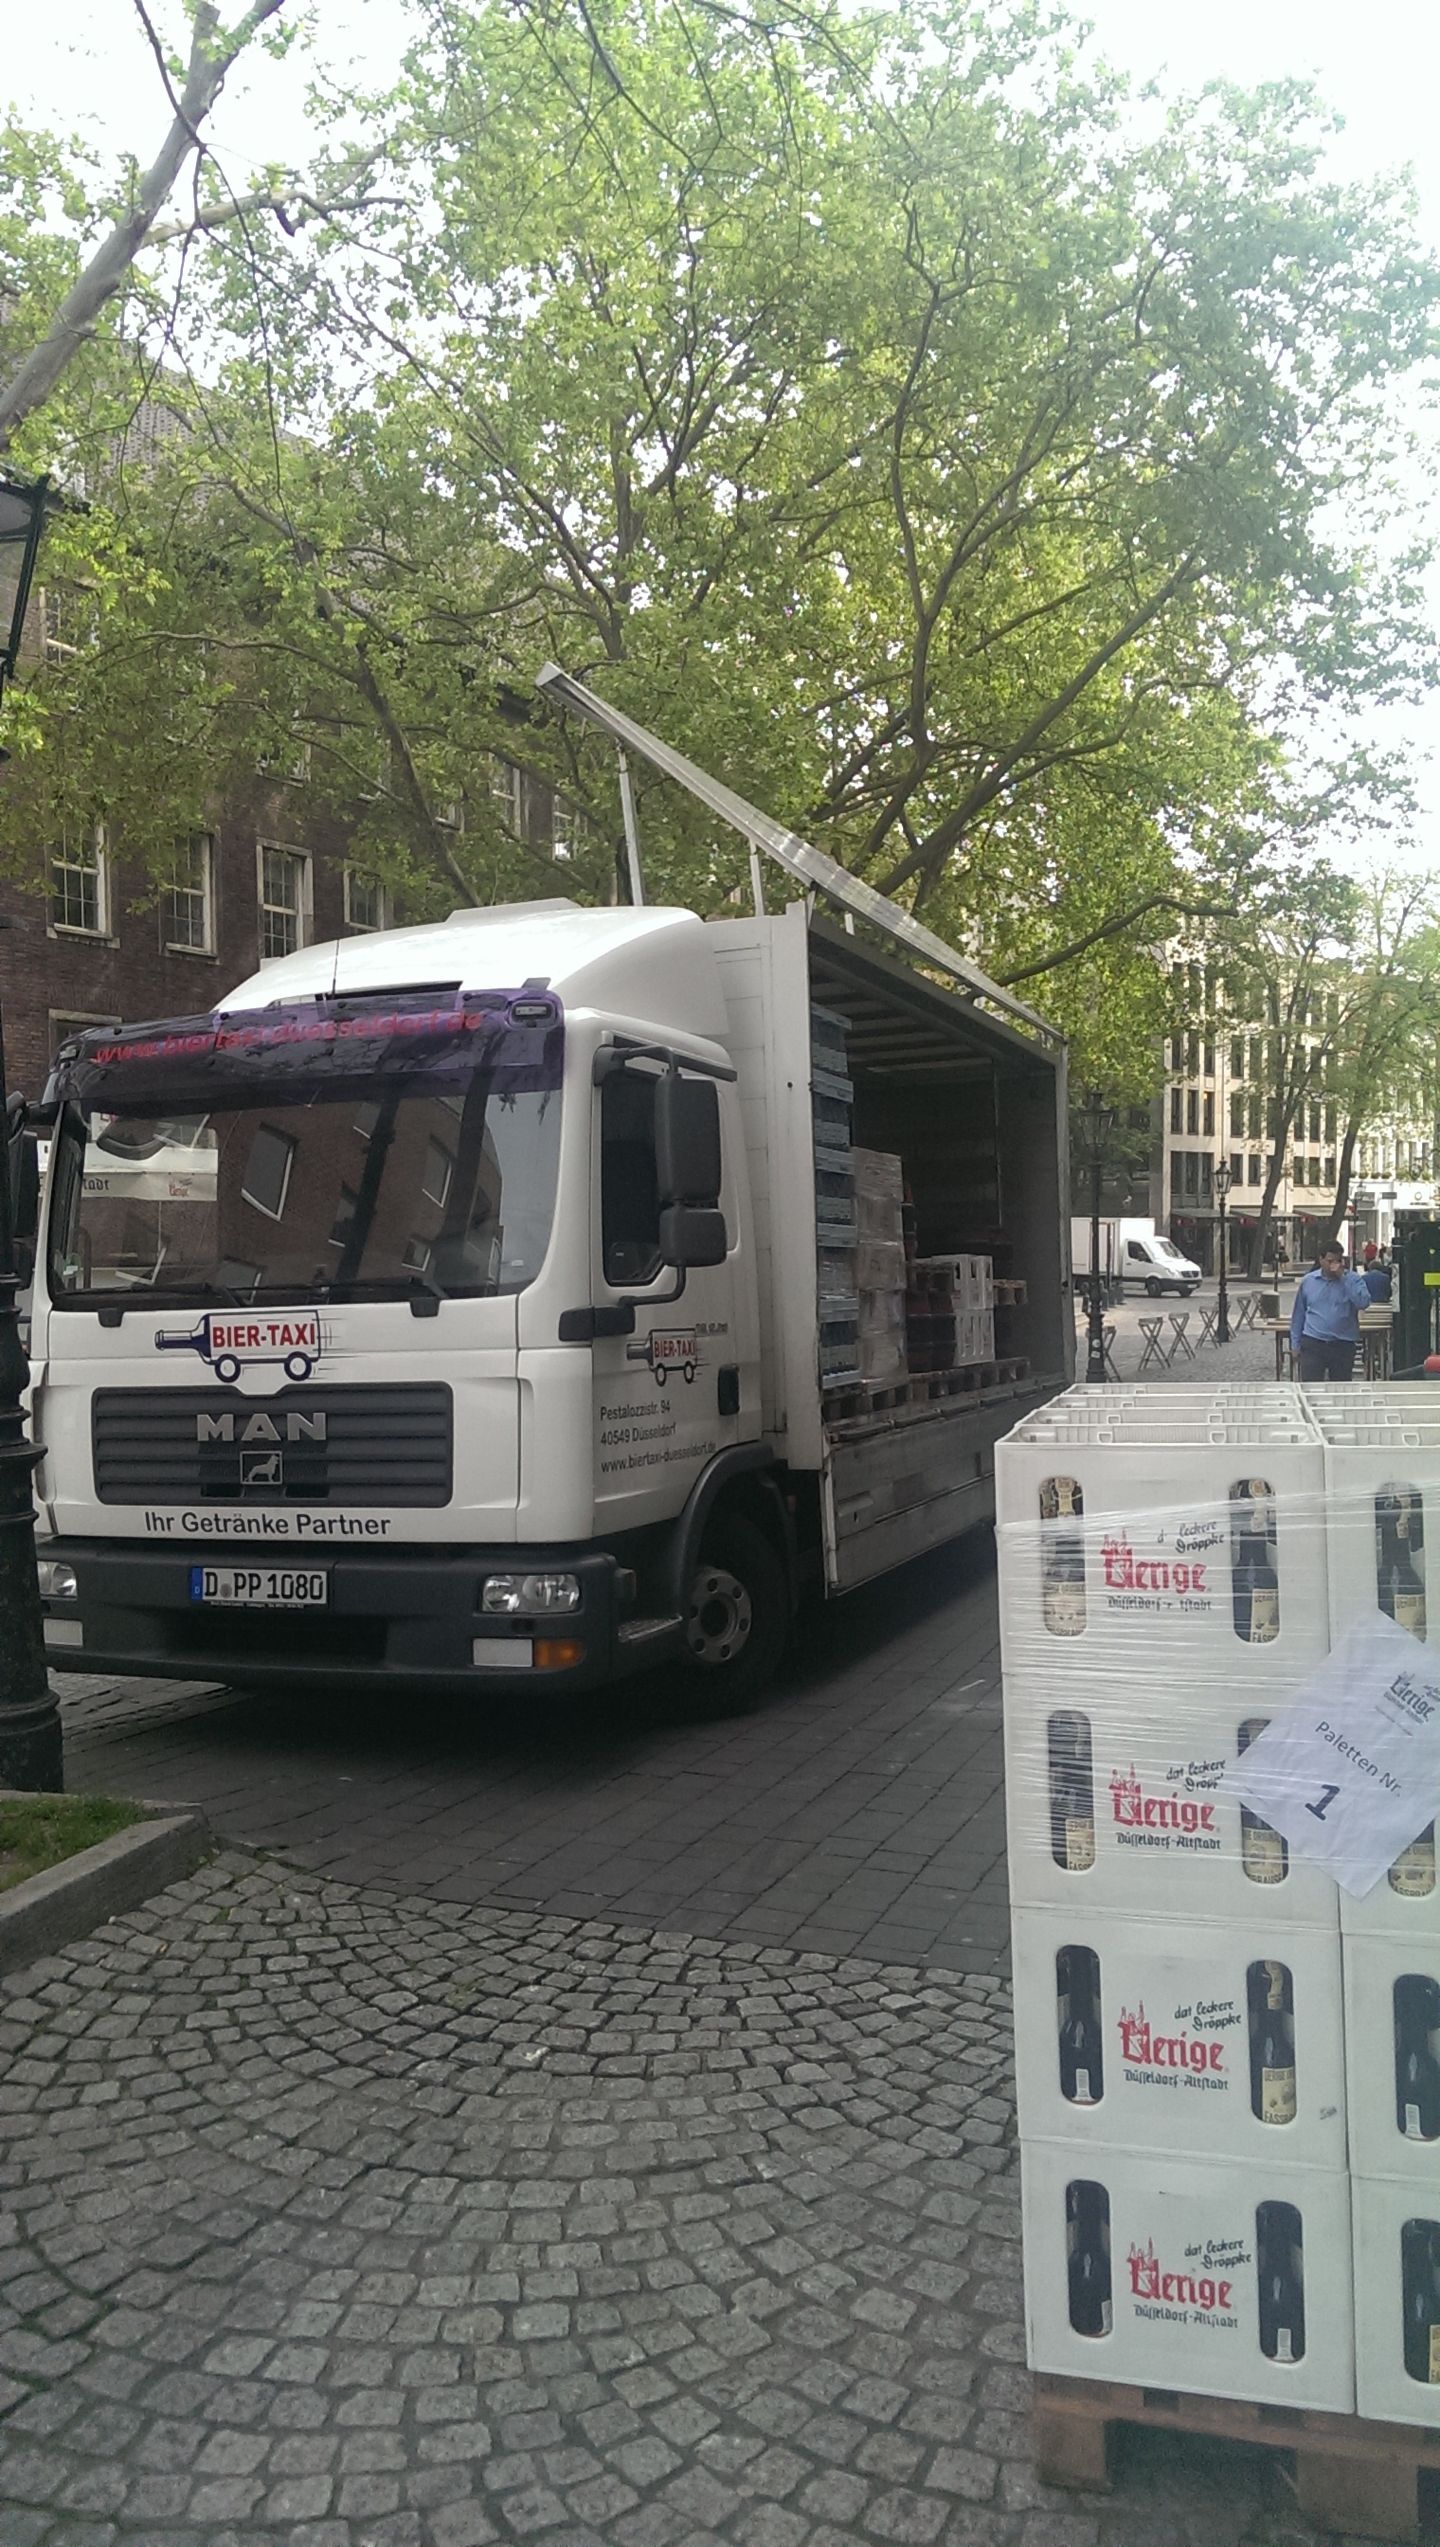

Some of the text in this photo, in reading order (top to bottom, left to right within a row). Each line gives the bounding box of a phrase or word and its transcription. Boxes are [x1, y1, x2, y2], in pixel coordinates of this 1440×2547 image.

[211, 1322, 316, 1349] BIER-TAXI
[654, 1338, 697, 1358] BIER-TAXI
[196, 1412, 326, 1441] MAN
[600, 1422, 676, 1447] 40549 Düsseldorf
[145, 1511, 391, 1535] Ihr Getränke Partner
[1100, 1547, 1207, 1595] Uerige
[233, 1572, 262, 1598] PP
[267, 1573, 323, 1600] 1080
[1187, 1758, 1227, 1776] leckere
[1315, 1721, 1379, 1777] Paletten
[1379, 1772, 1403, 1798] Nr.
[1108, 1783, 1216, 1834] Uerige
[1304, 1783, 1341, 1822] 1
[1174, 1999, 1235, 2019] dat leckere
[1117, 2020, 1225, 2074] Uerige
[1123, 2068, 1230, 2091] Düsseldorf-Altstadt
[1184, 2239, 1245, 2258] dat leckere
[1126, 2257, 1233, 2311] Uerige
